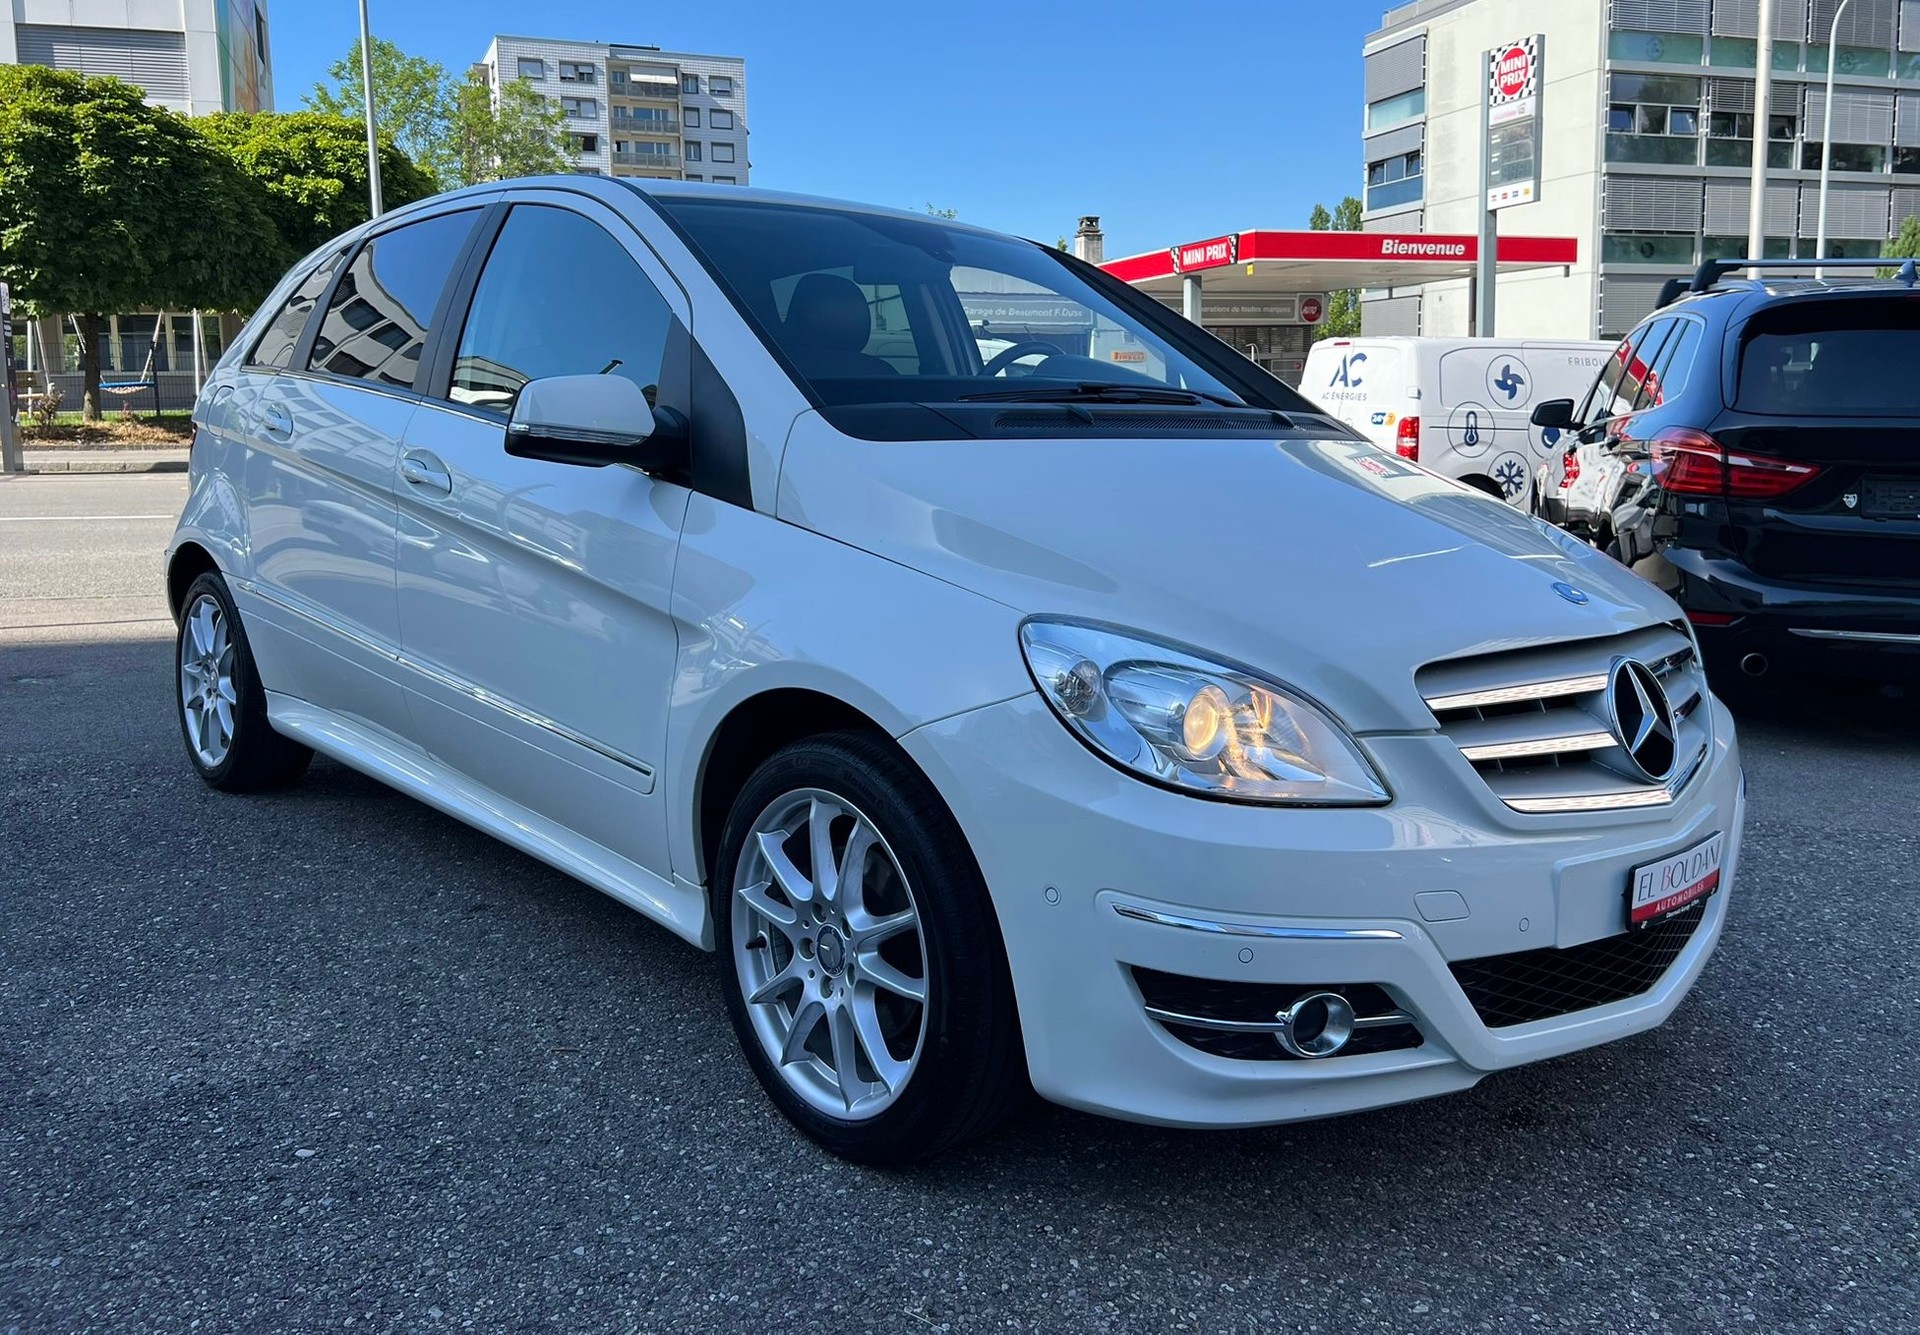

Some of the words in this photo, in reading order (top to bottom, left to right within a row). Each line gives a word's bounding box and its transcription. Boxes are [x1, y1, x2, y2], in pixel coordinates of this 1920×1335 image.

[1500, 54, 1526, 75] MINI
[1500, 70, 1525, 88] PRIX
[1183, 248, 1205, 266] MINI
[1206, 243, 1228, 262] PRIX
[1381, 239, 1466, 256] Bienvenue
[964, 306, 993, 318] Garage
[995, 306, 1007, 316] de
[1008, 307, 1054, 317] Beaumont
[1231, 305, 1240, 313] de
[1329, 353, 1367, 387] AC
[1568, 356, 1606, 367] FRIBOU
[1638, 872, 1655, 902] EL
